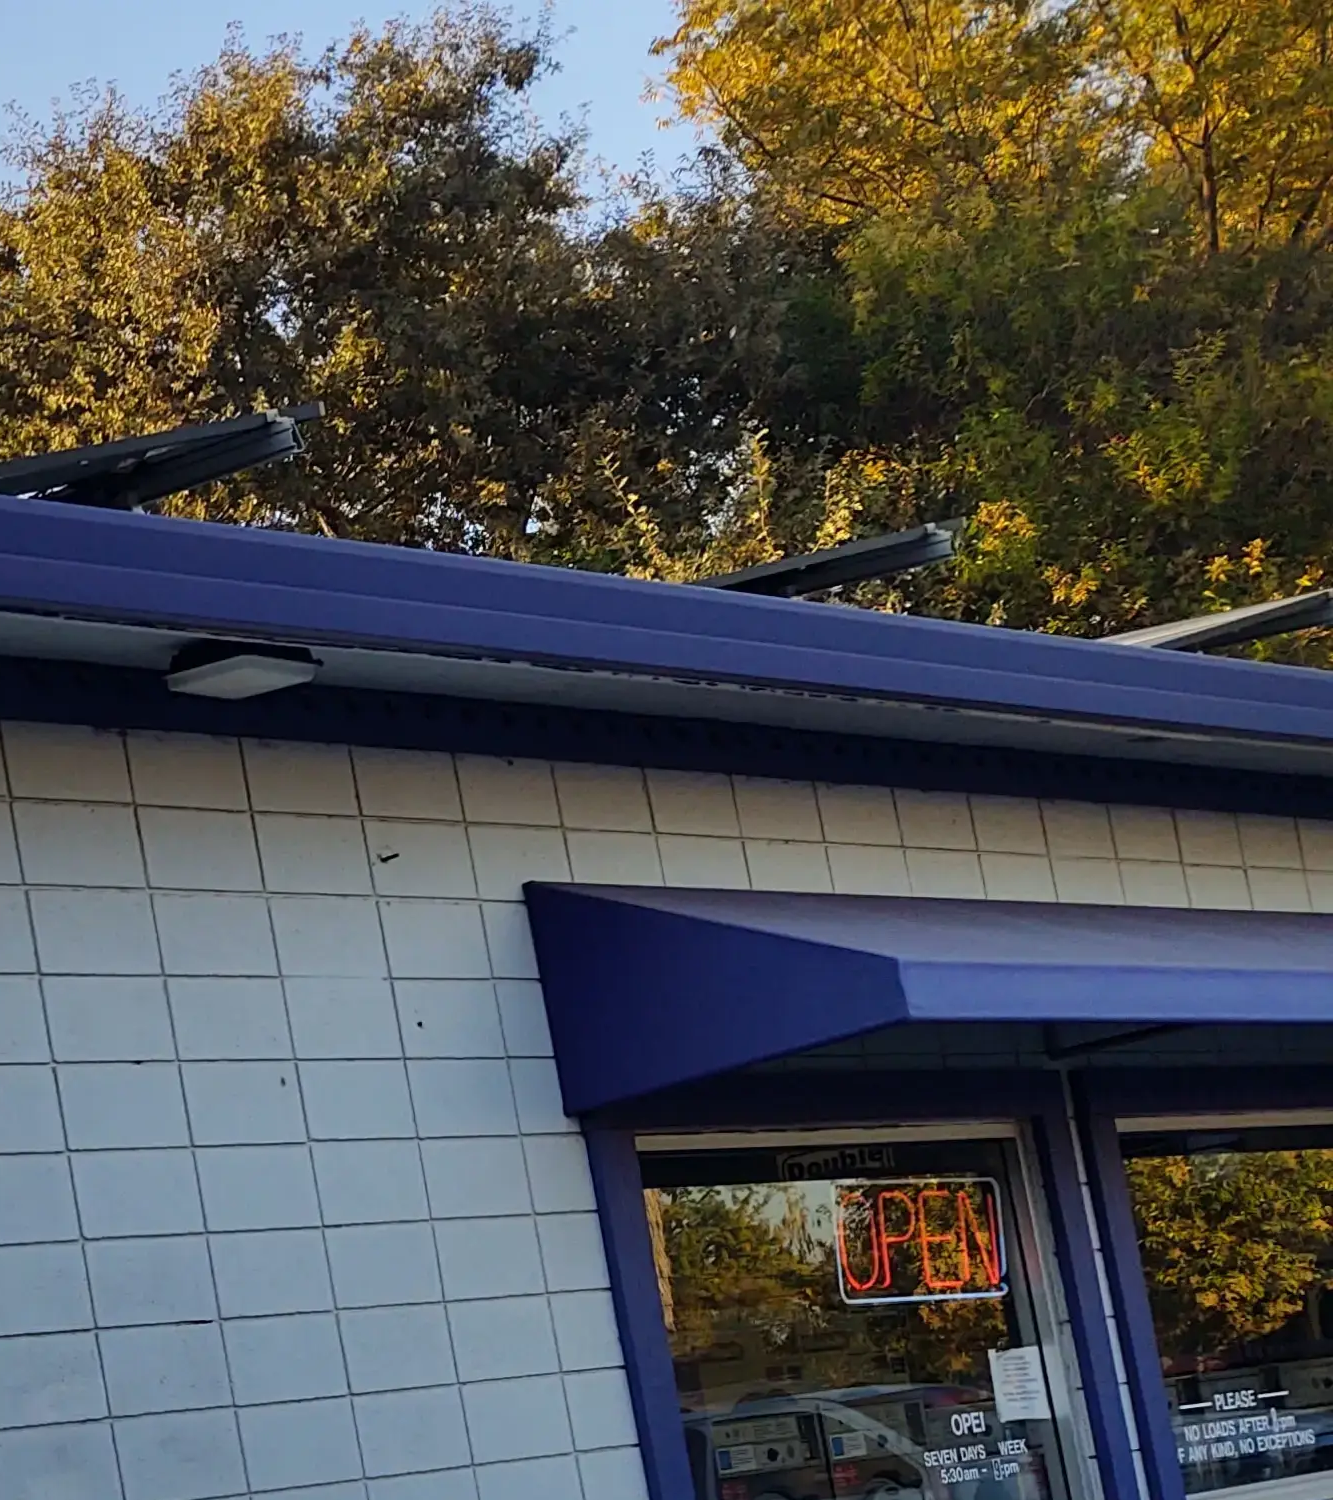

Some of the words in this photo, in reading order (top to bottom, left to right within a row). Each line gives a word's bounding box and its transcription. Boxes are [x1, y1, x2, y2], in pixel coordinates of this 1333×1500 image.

[786, 1148, 883, 1180] Double
[837, 1187, 1001, 1292] OPEN
[1213, 1389, 1257, 1411] PLEASE
[950, 1411, 987, 1436] OPE
[1183, 1423, 1201, 1442] NO
[1202, 1418, 1237, 1439] LOADS
[1239, 1415, 1271, 1434] AFTER
[923, 1447, 959, 1467] SEVEN
[959, 1443, 987, 1461] DAYS
[997, 1438, 1029, 1456] WEEK
[1188, 1444, 1208, 1462] ANY
[1211, 1439, 1239, 1459] KIND,
[1240, 1436, 1256, 1455] NO
[1256, 1428, 1316, 1450] EXCEPTIONS
